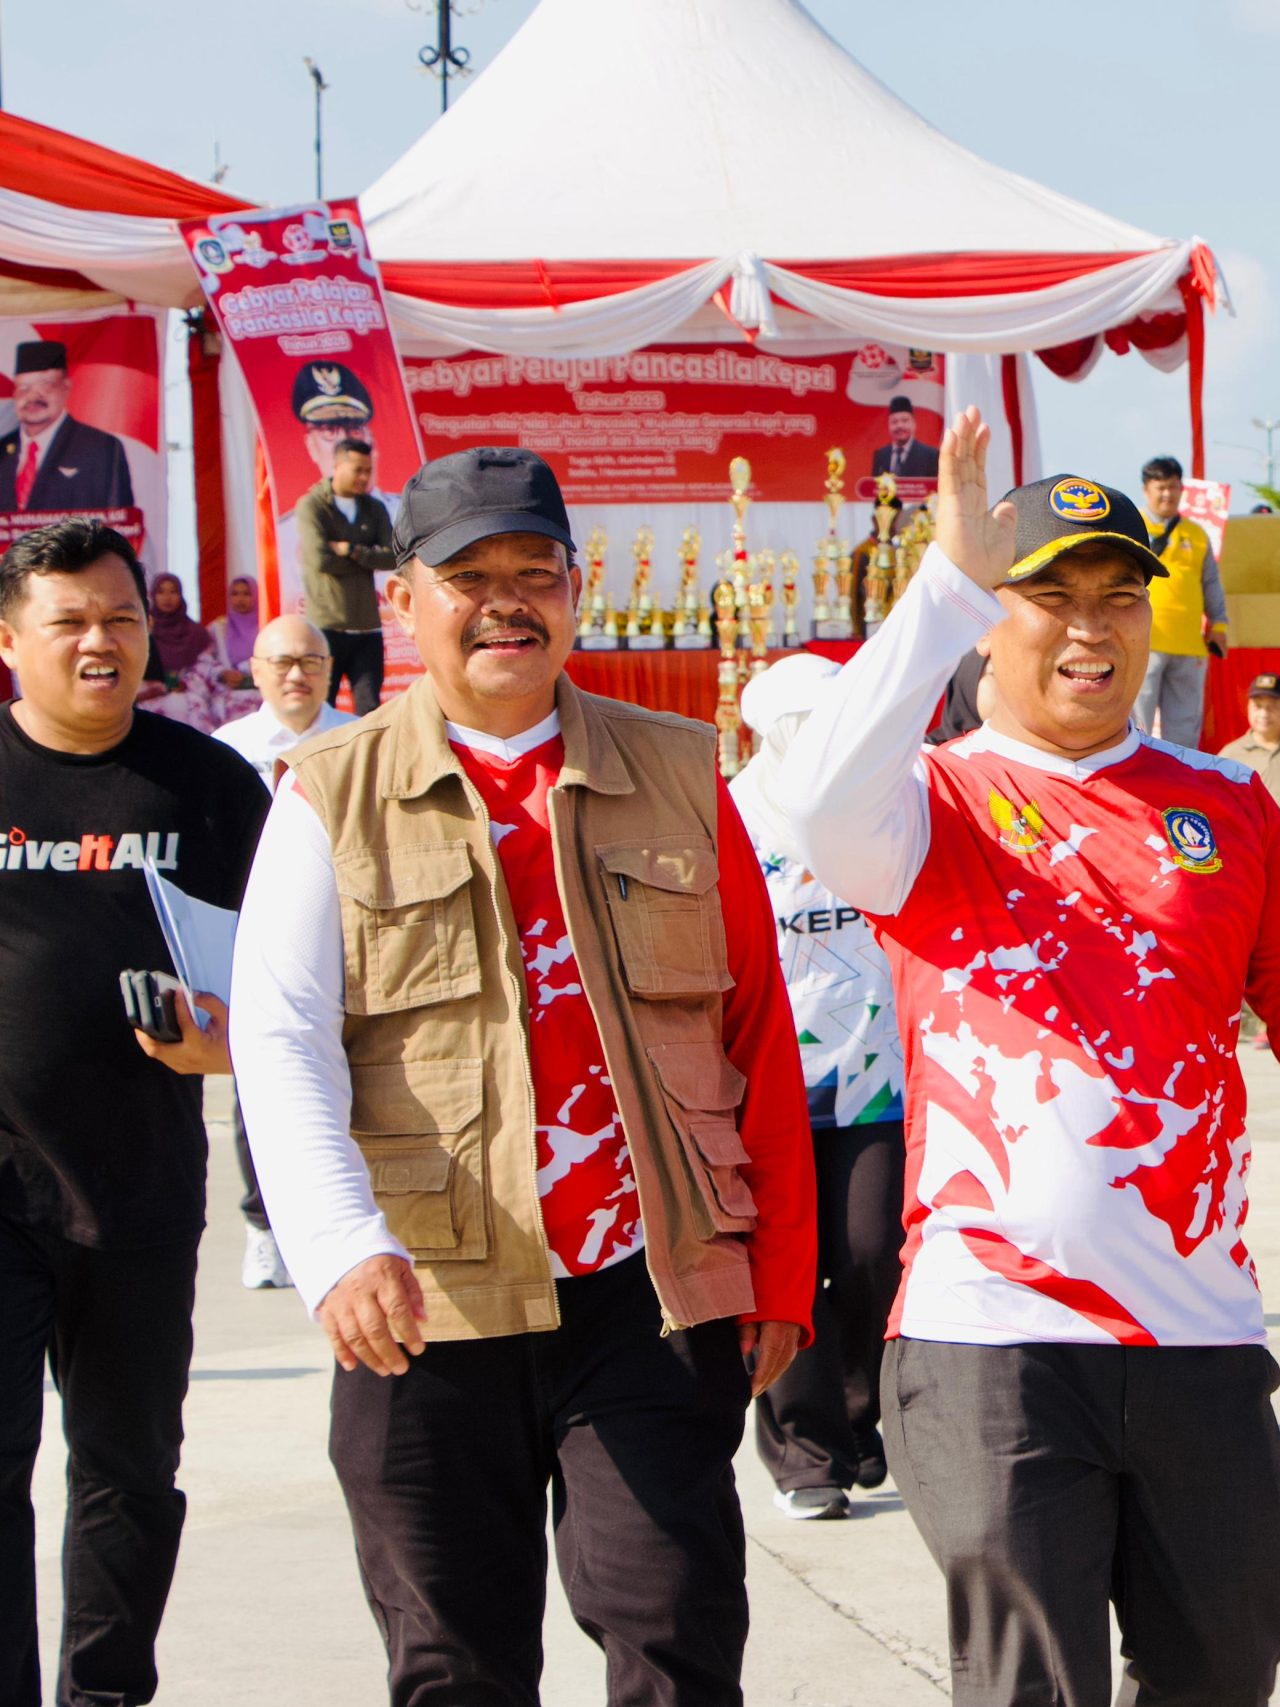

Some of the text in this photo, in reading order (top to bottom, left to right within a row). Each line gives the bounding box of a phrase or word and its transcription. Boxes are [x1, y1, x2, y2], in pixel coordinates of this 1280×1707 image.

[224, 279, 369, 313] Gebyar Pelajar
[228, 305, 381, 333] Pancasila Kepri
[510, 356, 608, 389] Pelajar
[615, 351, 753, 380] Pancasila
[759, 359, 831, 393] Kepri
[778, 906, 869, 935] KEP
